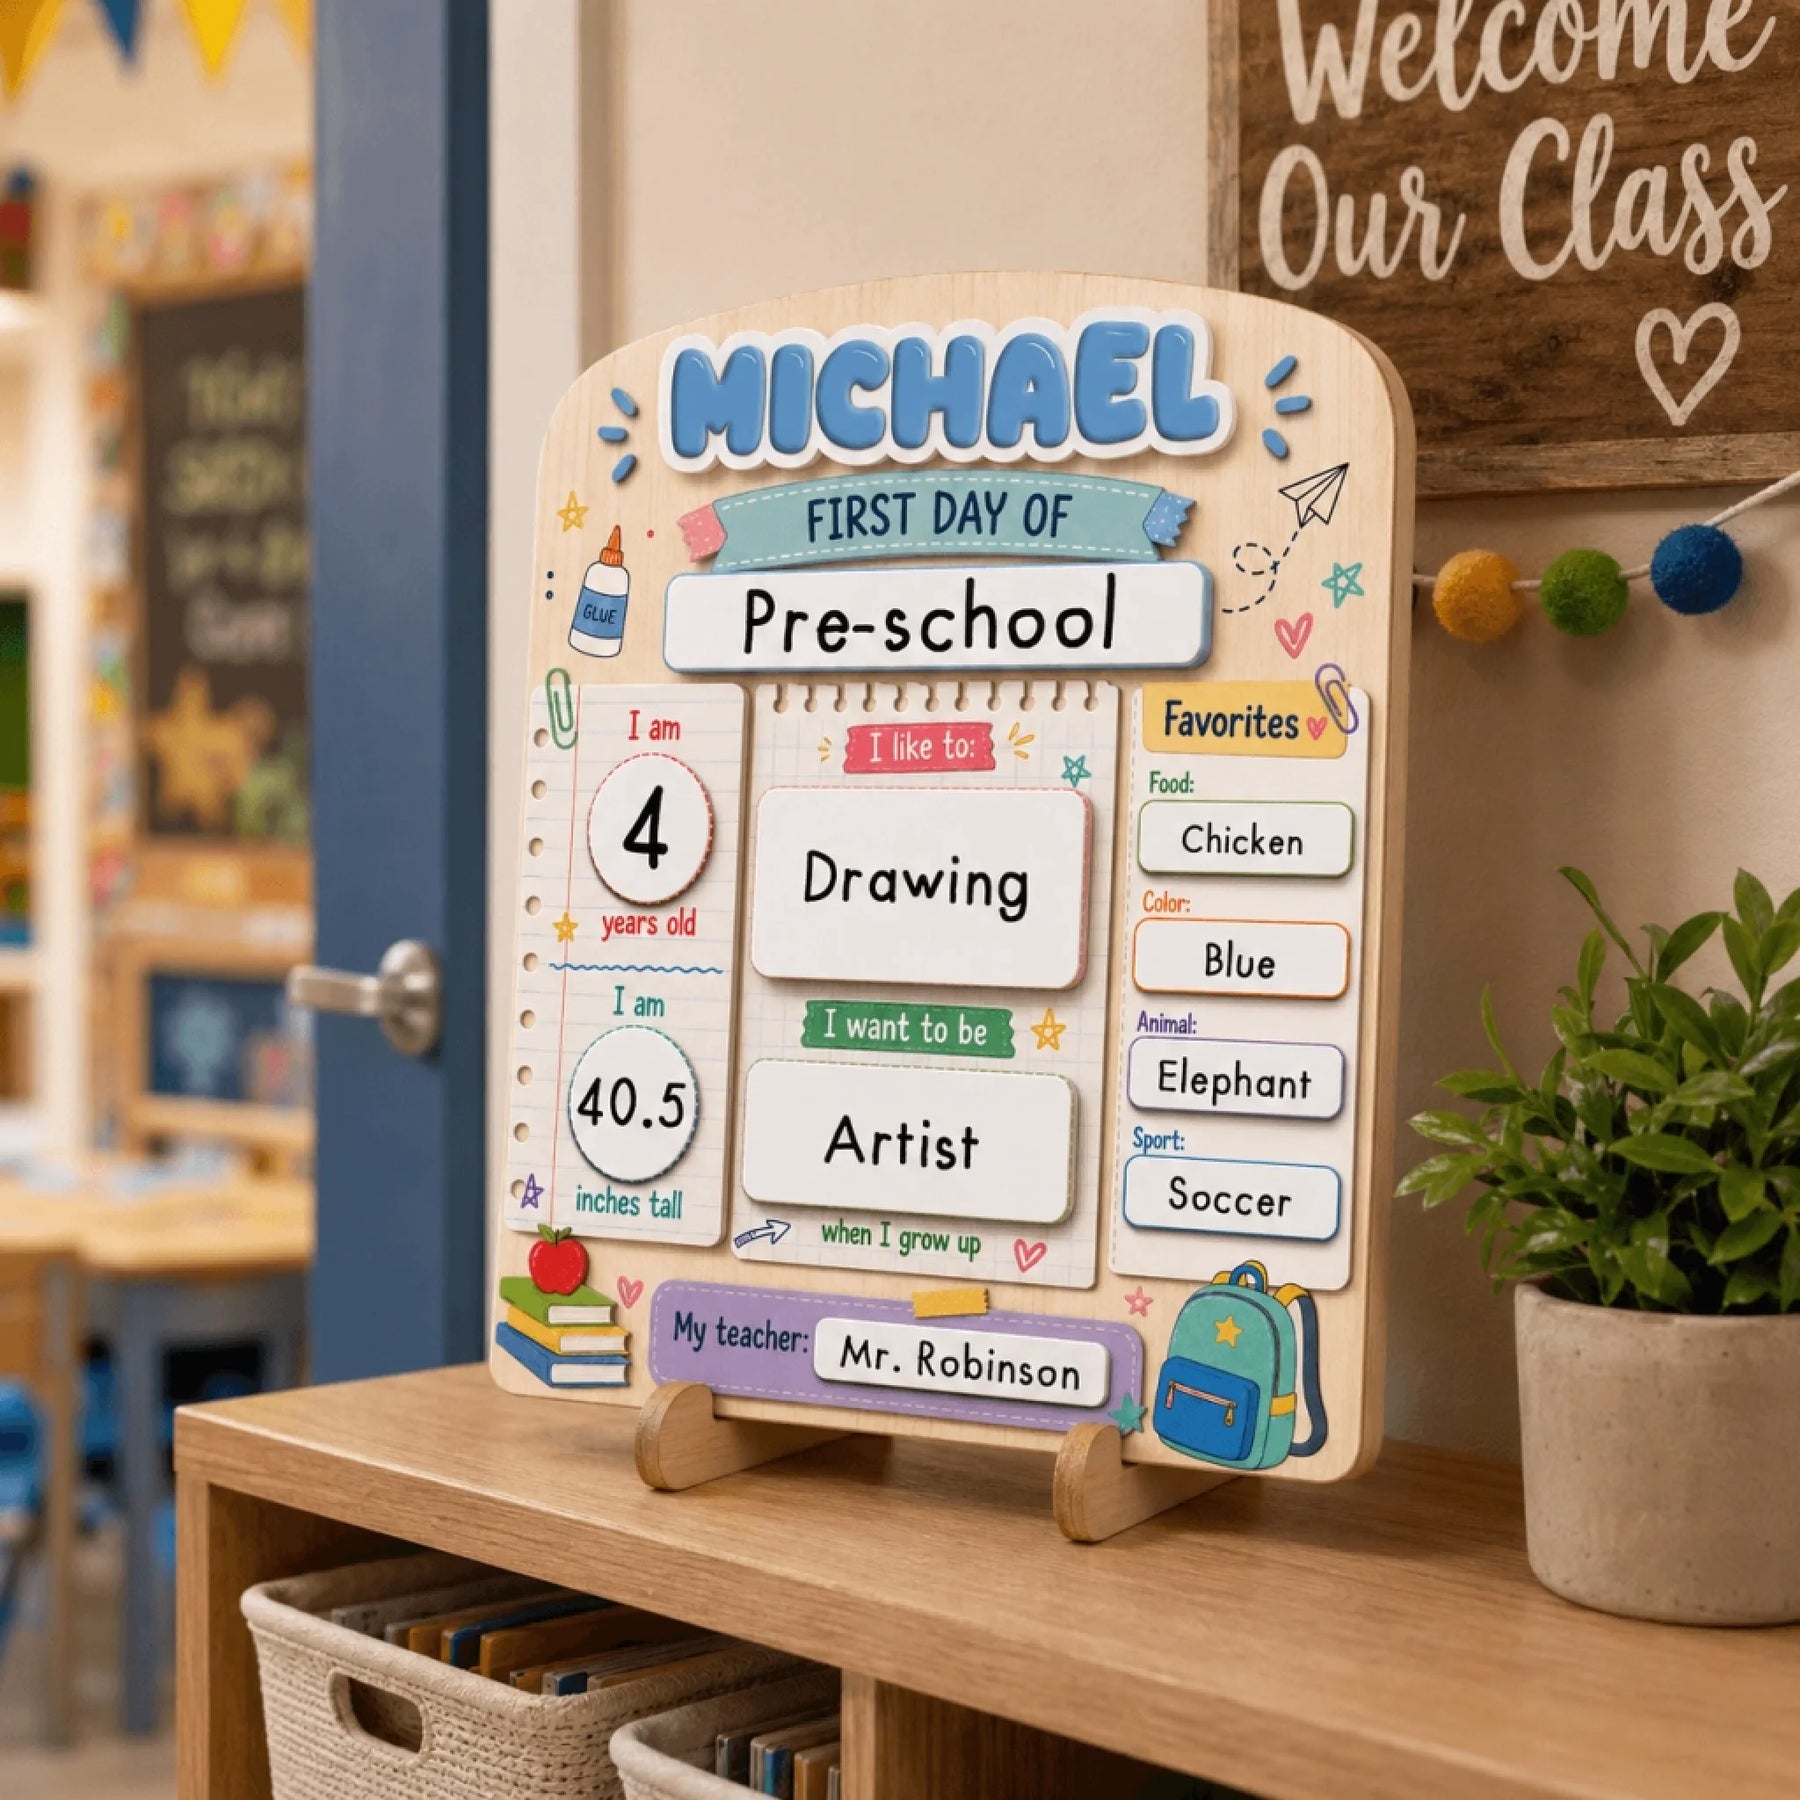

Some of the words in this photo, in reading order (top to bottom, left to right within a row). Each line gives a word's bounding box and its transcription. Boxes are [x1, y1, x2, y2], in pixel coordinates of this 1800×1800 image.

[1278, 0, 1776, 124] Welcome
[1259, 145, 1467, 290] Our
[1500, 113, 1788, 280] Class
[670, 320, 1220, 459] MICHAEL
[808, 492, 916, 542] FIRST
[933, 490, 1007, 537] DAY
[1024, 494, 1072, 538] OF
[583, 603, 618, 625] GLUE
[745, 573, 1115, 654] Pre-school
[629, 710, 640, 740] I
[649, 719, 680, 740] am
[1165, 700, 1298, 738] Favorites
[870, 733, 881, 762] I
[894, 732, 932, 760] like
[944, 731, 974, 759] to:
[1150, 771, 1194, 793] Food:
[623, 786, 668, 869] 4
[1183, 822, 1302, 854] Chicken
[805, 851, 1027, 922] Drawing
[1143, 890, 1190, 912] Color:
[602, 916, 657, 941] years
[668, 907, 696, 935] old
[1206, 940, 1274, 979] Blue
[613, 986, 624, 1015] I
[634, 997, 664, 1016] am
[824, 1009, 835, 1037] I
[847, 1013, 909, 1041] want
[921, 1014, 947, 1042] to
[960, 1014, 986, 1045] be
[1137, 1011, 1197, 1034] Animal:
[1159, 1057, 1311, 1106] Elephant
[578, 1078, 686, 1128] 40.5
[824, 1116, 979, 1170] Artist
[1133, 1127, 1185, 1154] Sport:
[577, 1185, 640, 1215] inches
[649, 1190, 682, 1219] tall
[1169, 1176, 1291, 1216] Soccer
[822, 1222, 870, 1246] when
[879, 1221, 891, 1247] I
[900, 1232, 949, 1256] grow
[958, 1236, 981, 1262] up
[674, 1311, 706, 1352] My
[717, 1317, 808, 1352] teacher:
[840, 1336, 900, 1372] Mr.
[918, 1341, 1079, 1390] Robinson
